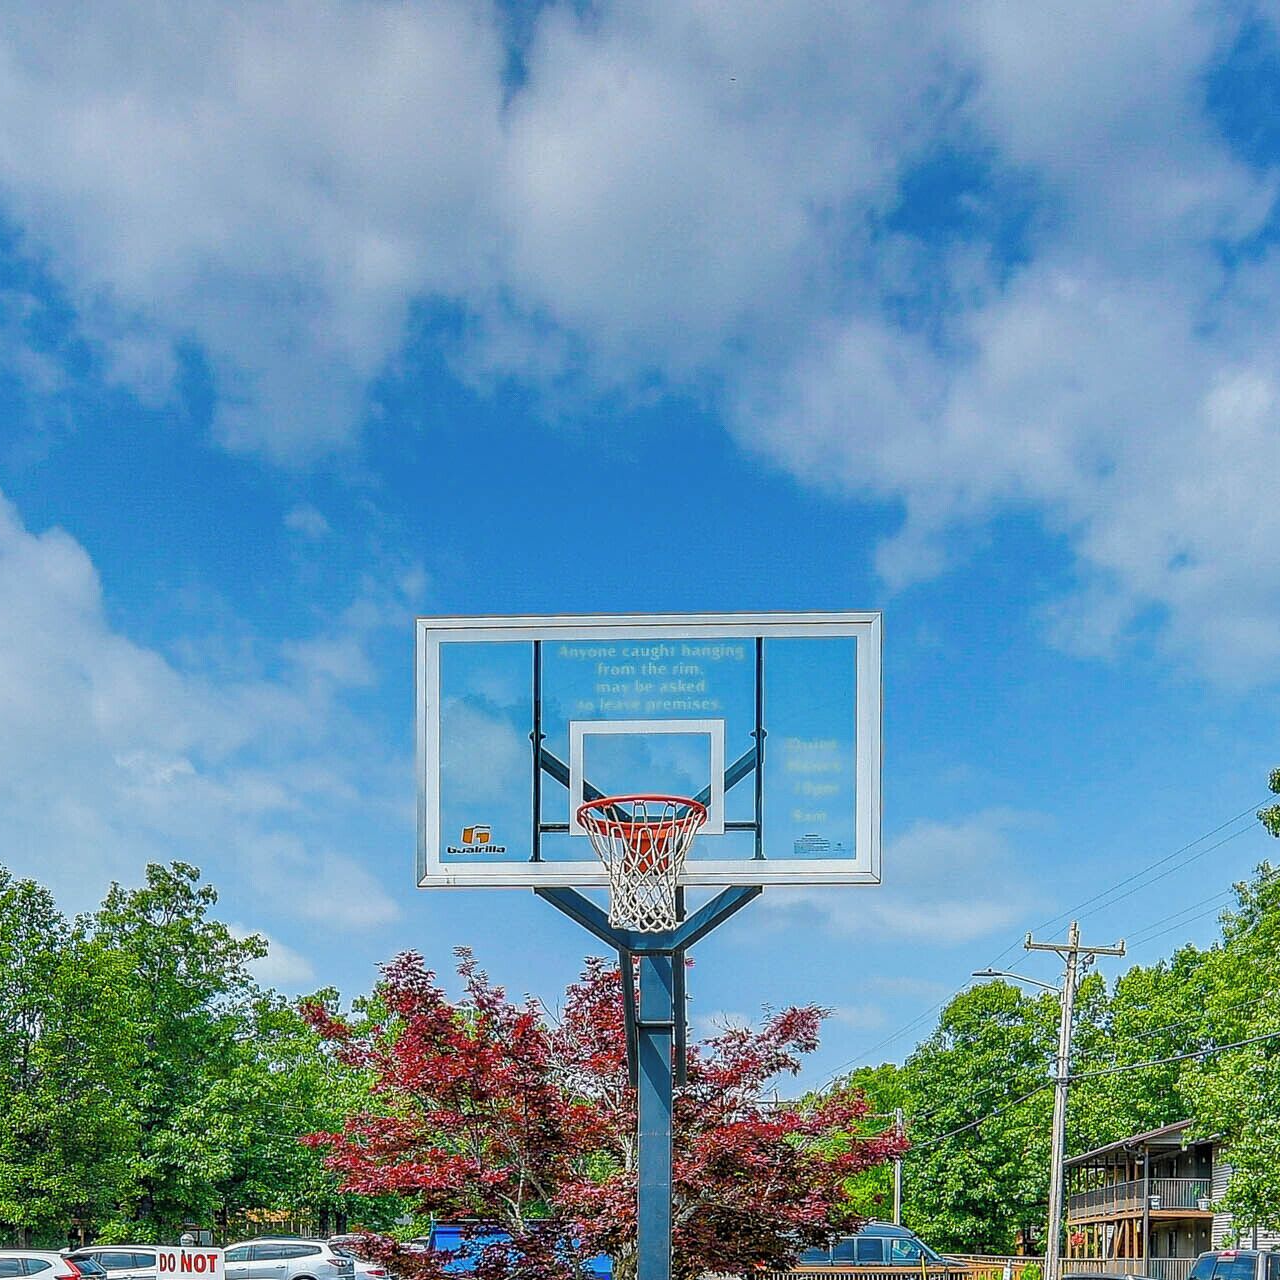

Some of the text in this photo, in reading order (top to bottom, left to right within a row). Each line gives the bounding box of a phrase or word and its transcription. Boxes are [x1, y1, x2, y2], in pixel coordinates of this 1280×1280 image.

[559, 644, 745, 661] Anyone caught hanging
[597, 662, 635, 676] from
[641, 662, 667, 676] the
[596, 680, 706, 696] may be asked
[159, 1253, 218, 1273] DO NOT
